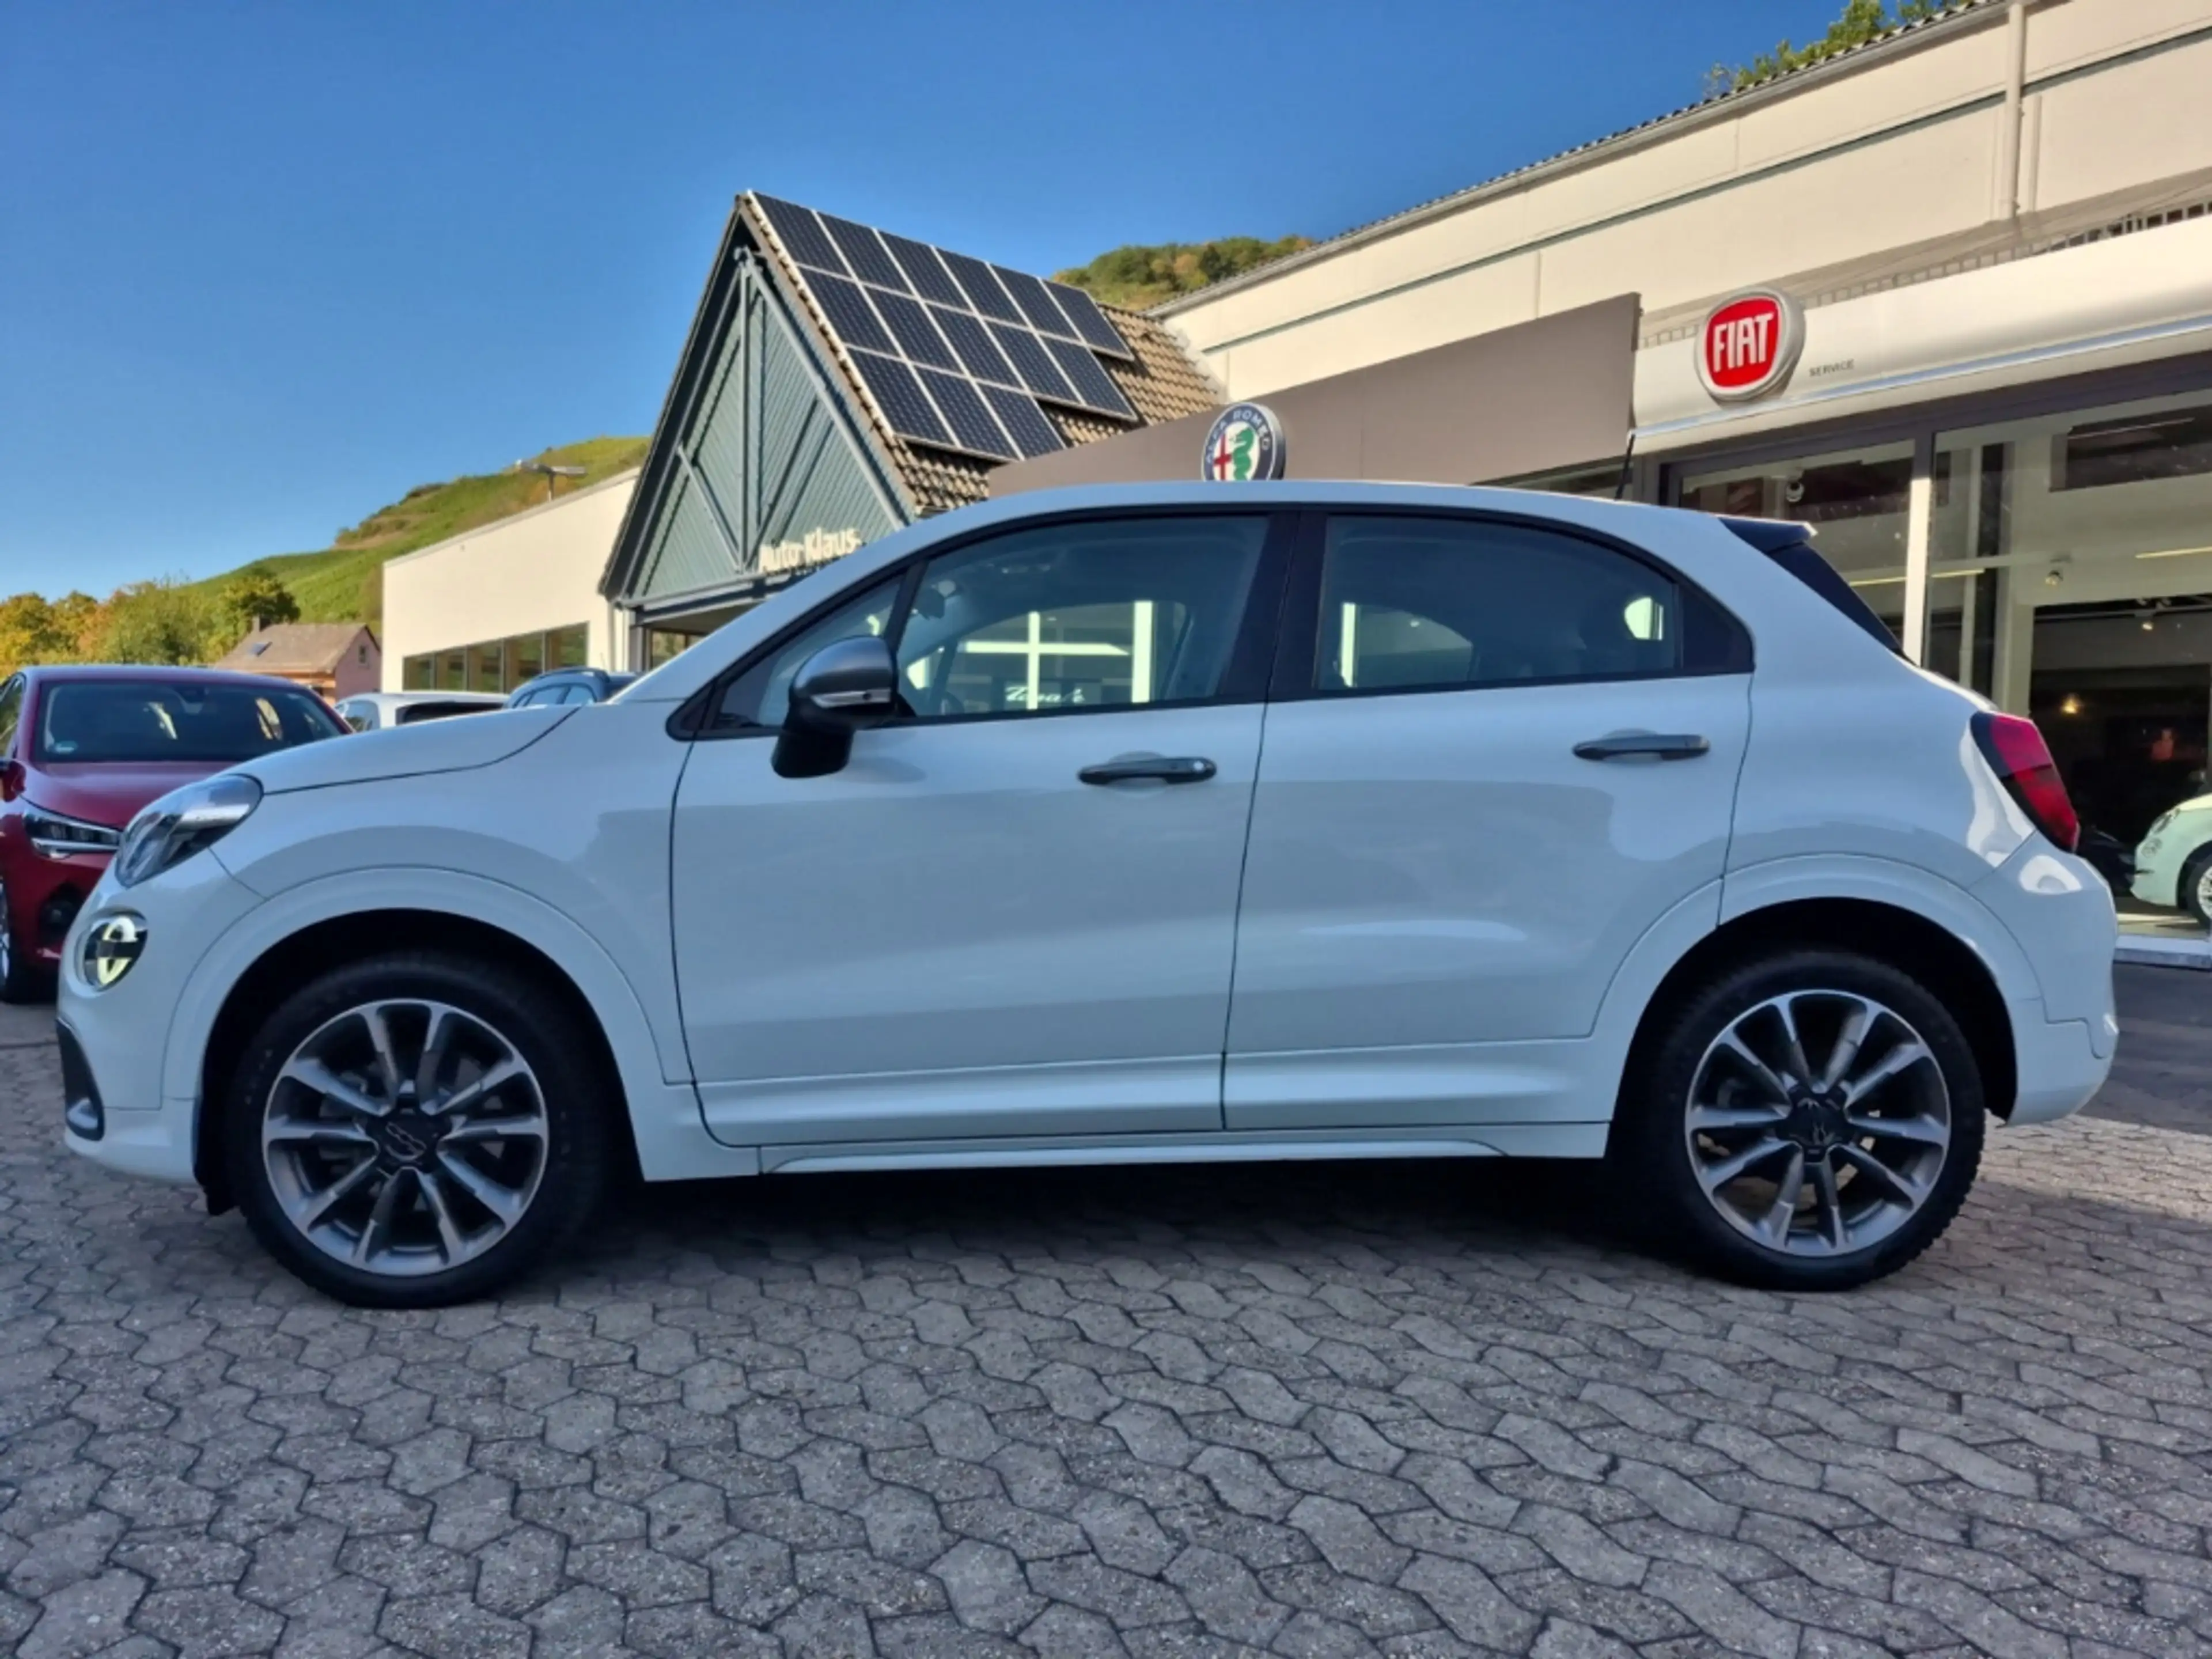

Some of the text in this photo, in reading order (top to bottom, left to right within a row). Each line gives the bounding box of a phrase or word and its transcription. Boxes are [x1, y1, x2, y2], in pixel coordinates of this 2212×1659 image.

[1713, 312, 1774, 373] FIAT
[1809, 358, 1854, 376] SERVICE
[759, 540, 804, 573] Auto
